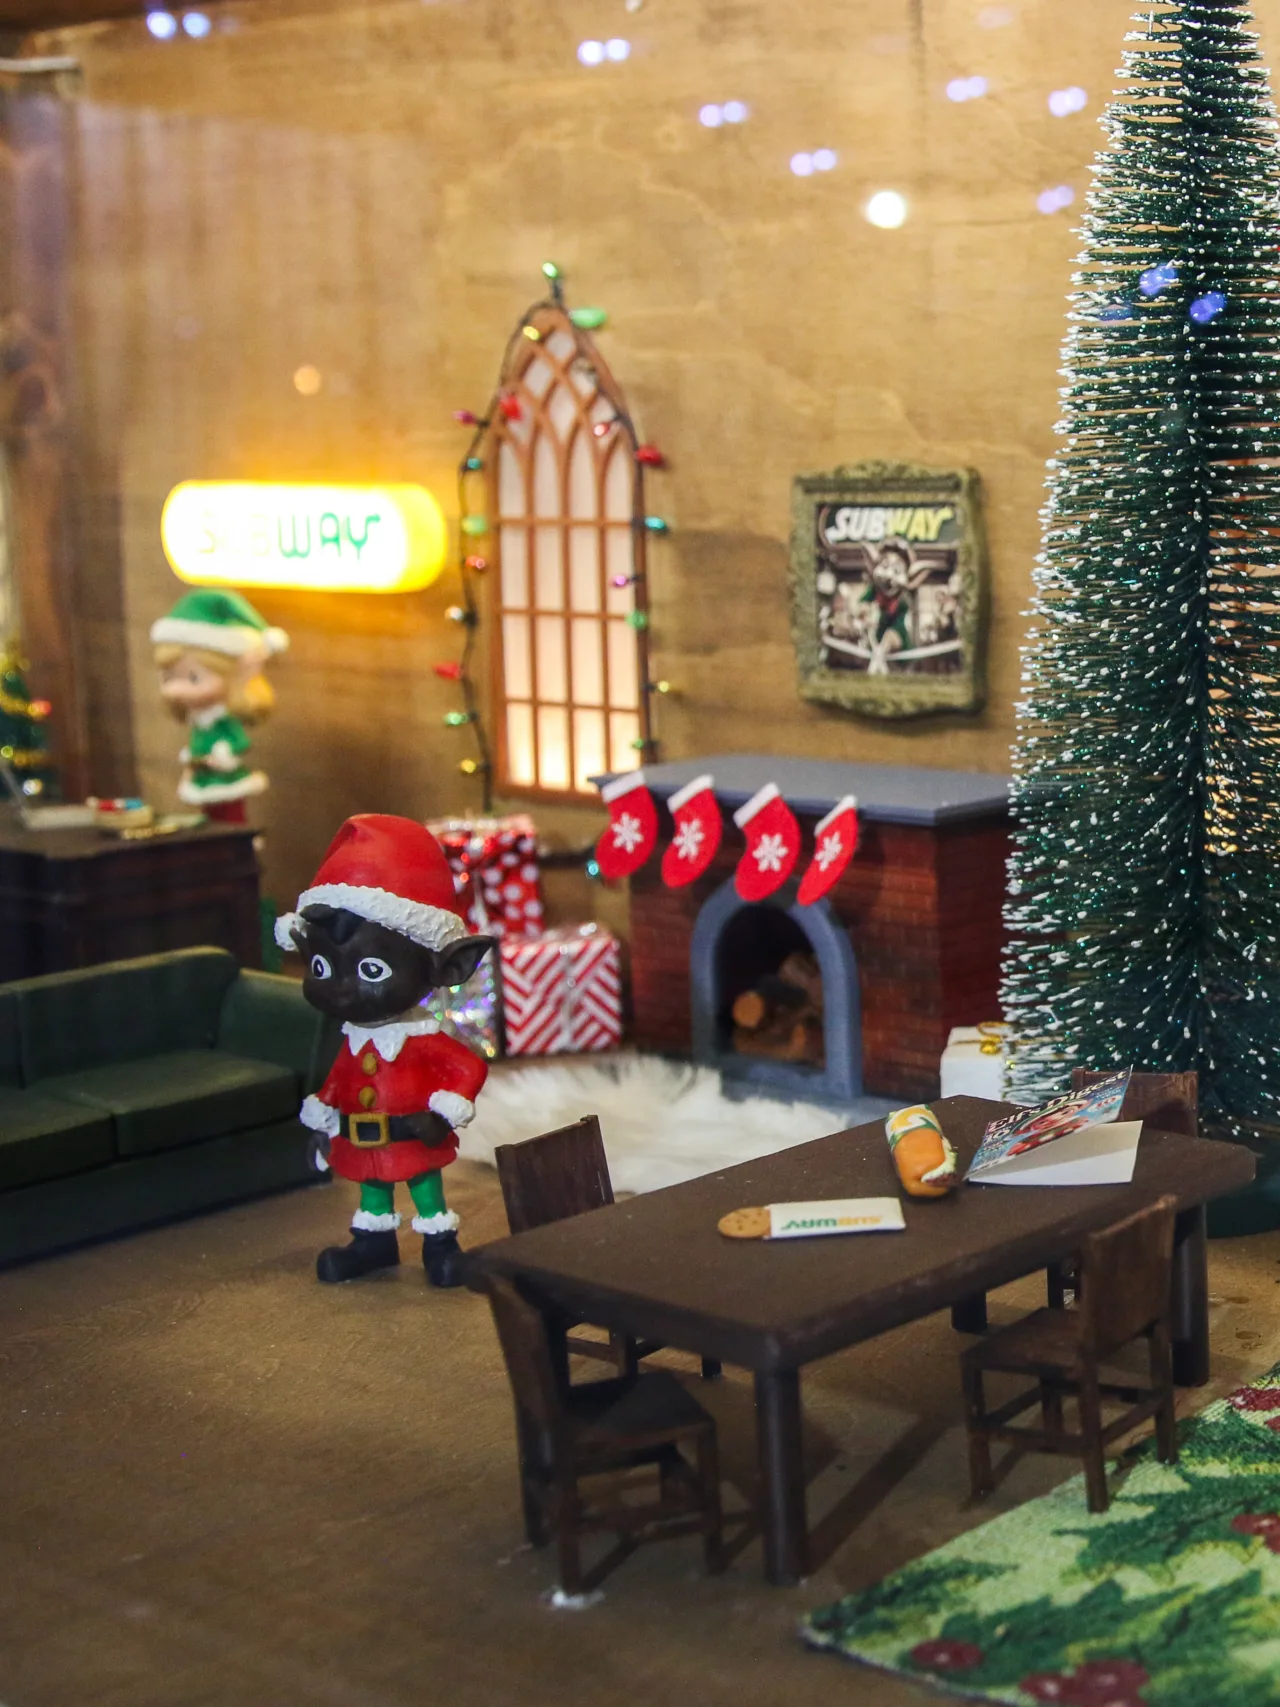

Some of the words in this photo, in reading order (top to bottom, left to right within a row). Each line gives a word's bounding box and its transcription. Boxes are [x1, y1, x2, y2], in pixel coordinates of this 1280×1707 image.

[197, 509, 382, 561] SBWAY
[825, 506, 954, 543] SUBWAY
[1047, 1070, 1127, 1110] Digest
